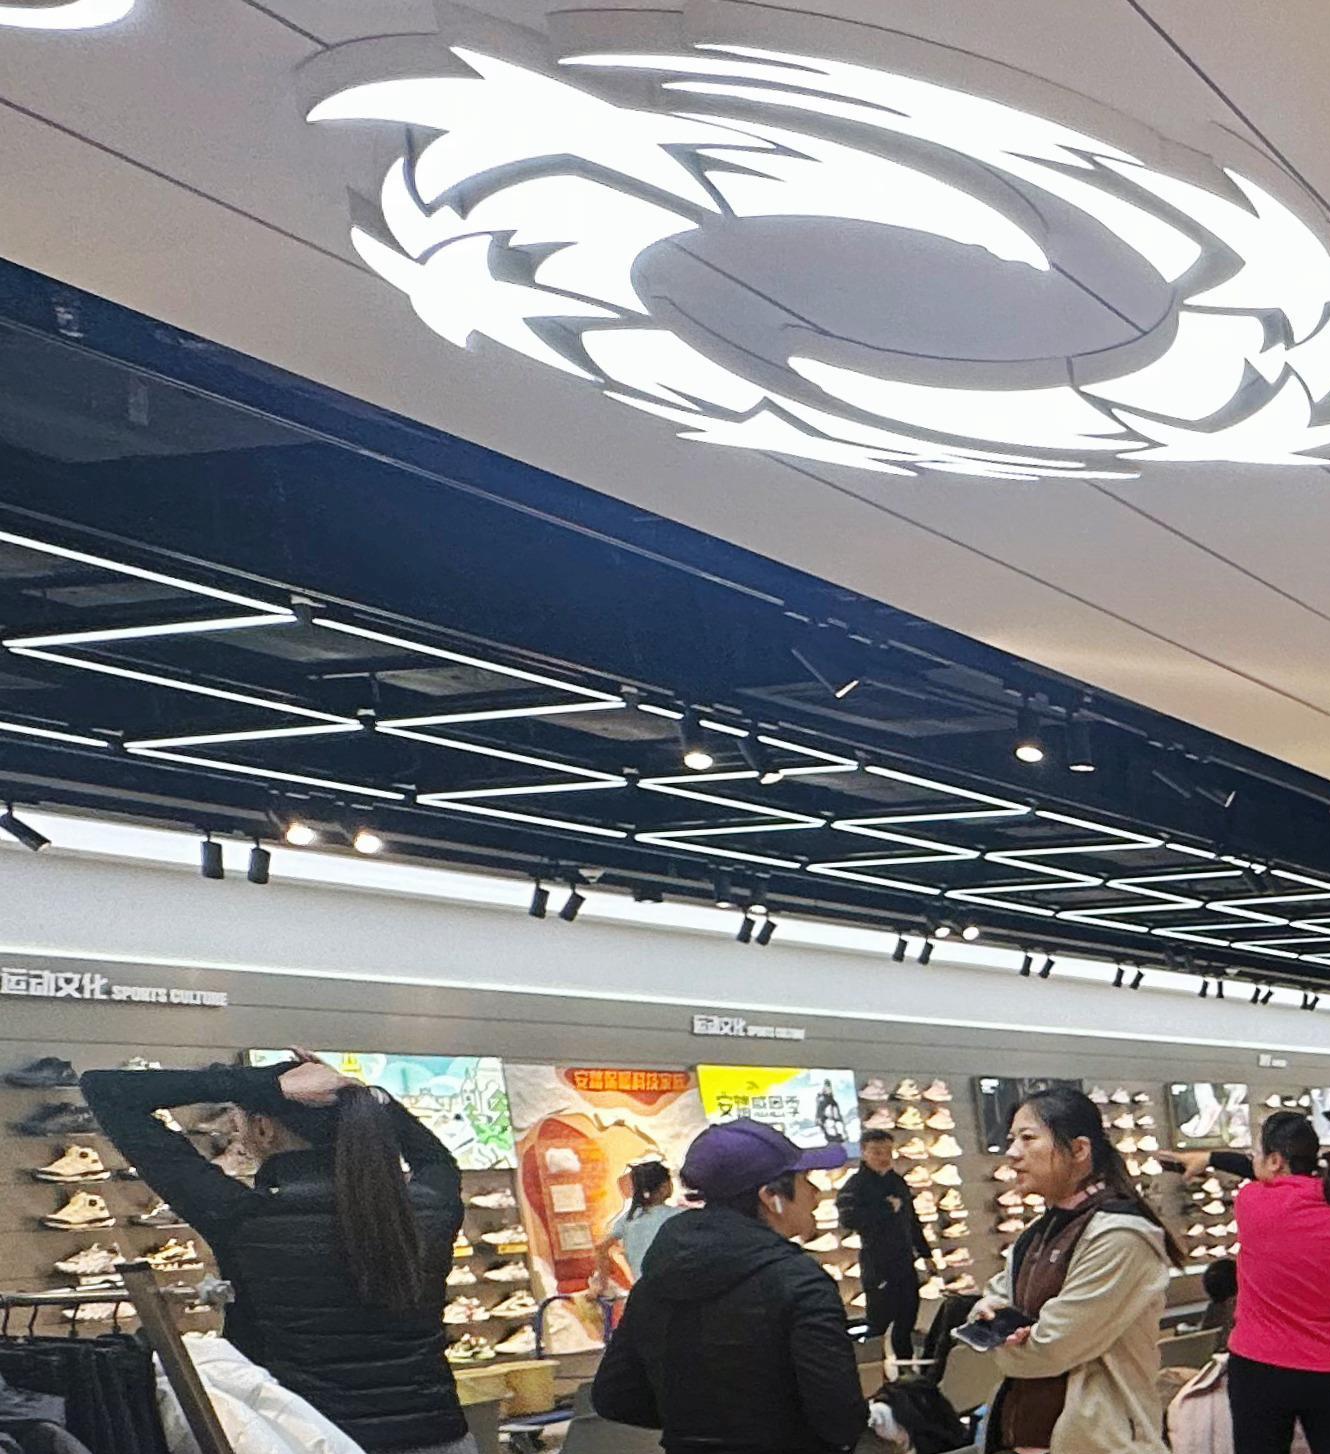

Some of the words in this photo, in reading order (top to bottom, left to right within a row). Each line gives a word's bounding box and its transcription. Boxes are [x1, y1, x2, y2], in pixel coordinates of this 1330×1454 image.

[0, 967, 109, 1000] 运动文化
[111, 985, 168, 1003] SPORTS
[169, 988, 228, 1007] CULTURE
